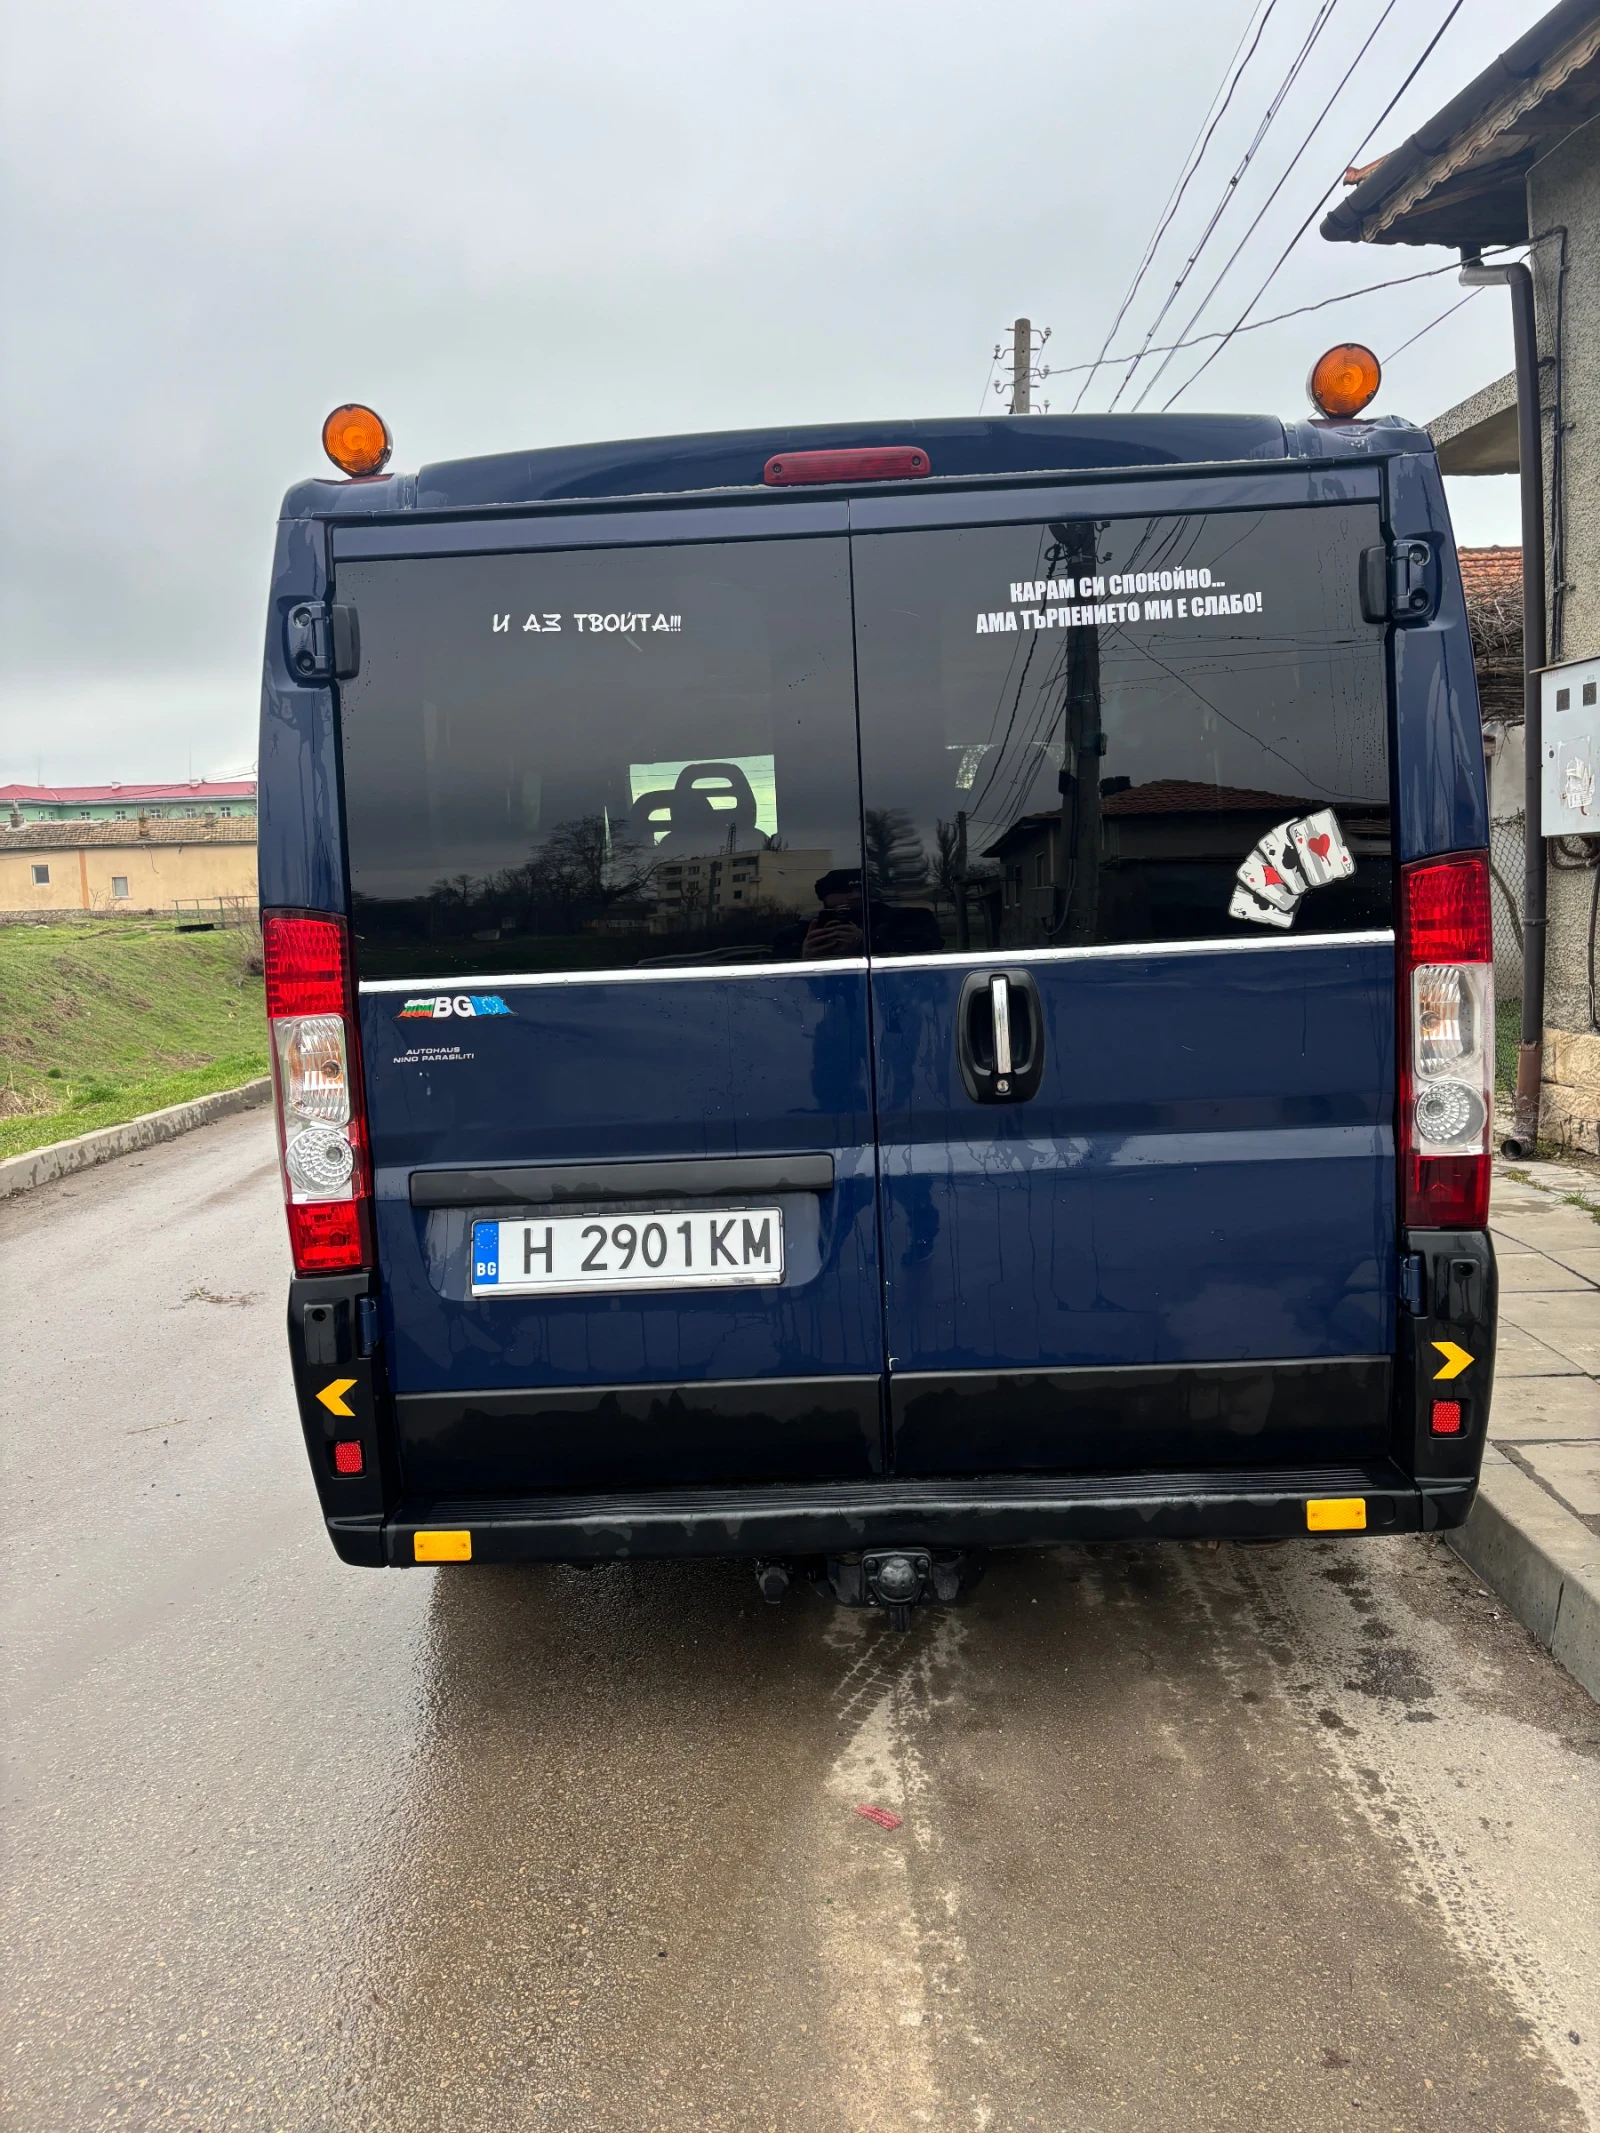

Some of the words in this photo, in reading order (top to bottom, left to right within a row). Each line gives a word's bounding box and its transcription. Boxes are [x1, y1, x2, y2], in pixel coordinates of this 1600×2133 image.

[1010, 578, 1075, 602] КАРАМ
[1079, 576, 1105, 597] СИ
[1109, 566, 1225, 595] СПОКОЙНО...
[976, 610, 1017, 633] АМА
[1021, 603, 1139, 630] ТЪРПЕНИЕТО
[1144, 600, 1174, 620] МИ
[1177, 598, 1189, 618] Е
[1191, 592, 1263, 616] СЛАБО!
[492, 613, 511, 633] И
[522, 613, 562, 633] АЗ
[433, 996, 477, 1018] BG
[406, 1047, 460, 1055] AUTOHAUS
[422, 1053, 474, 1061] PARASILITI
[476, 1262, 497, 1276] BG
